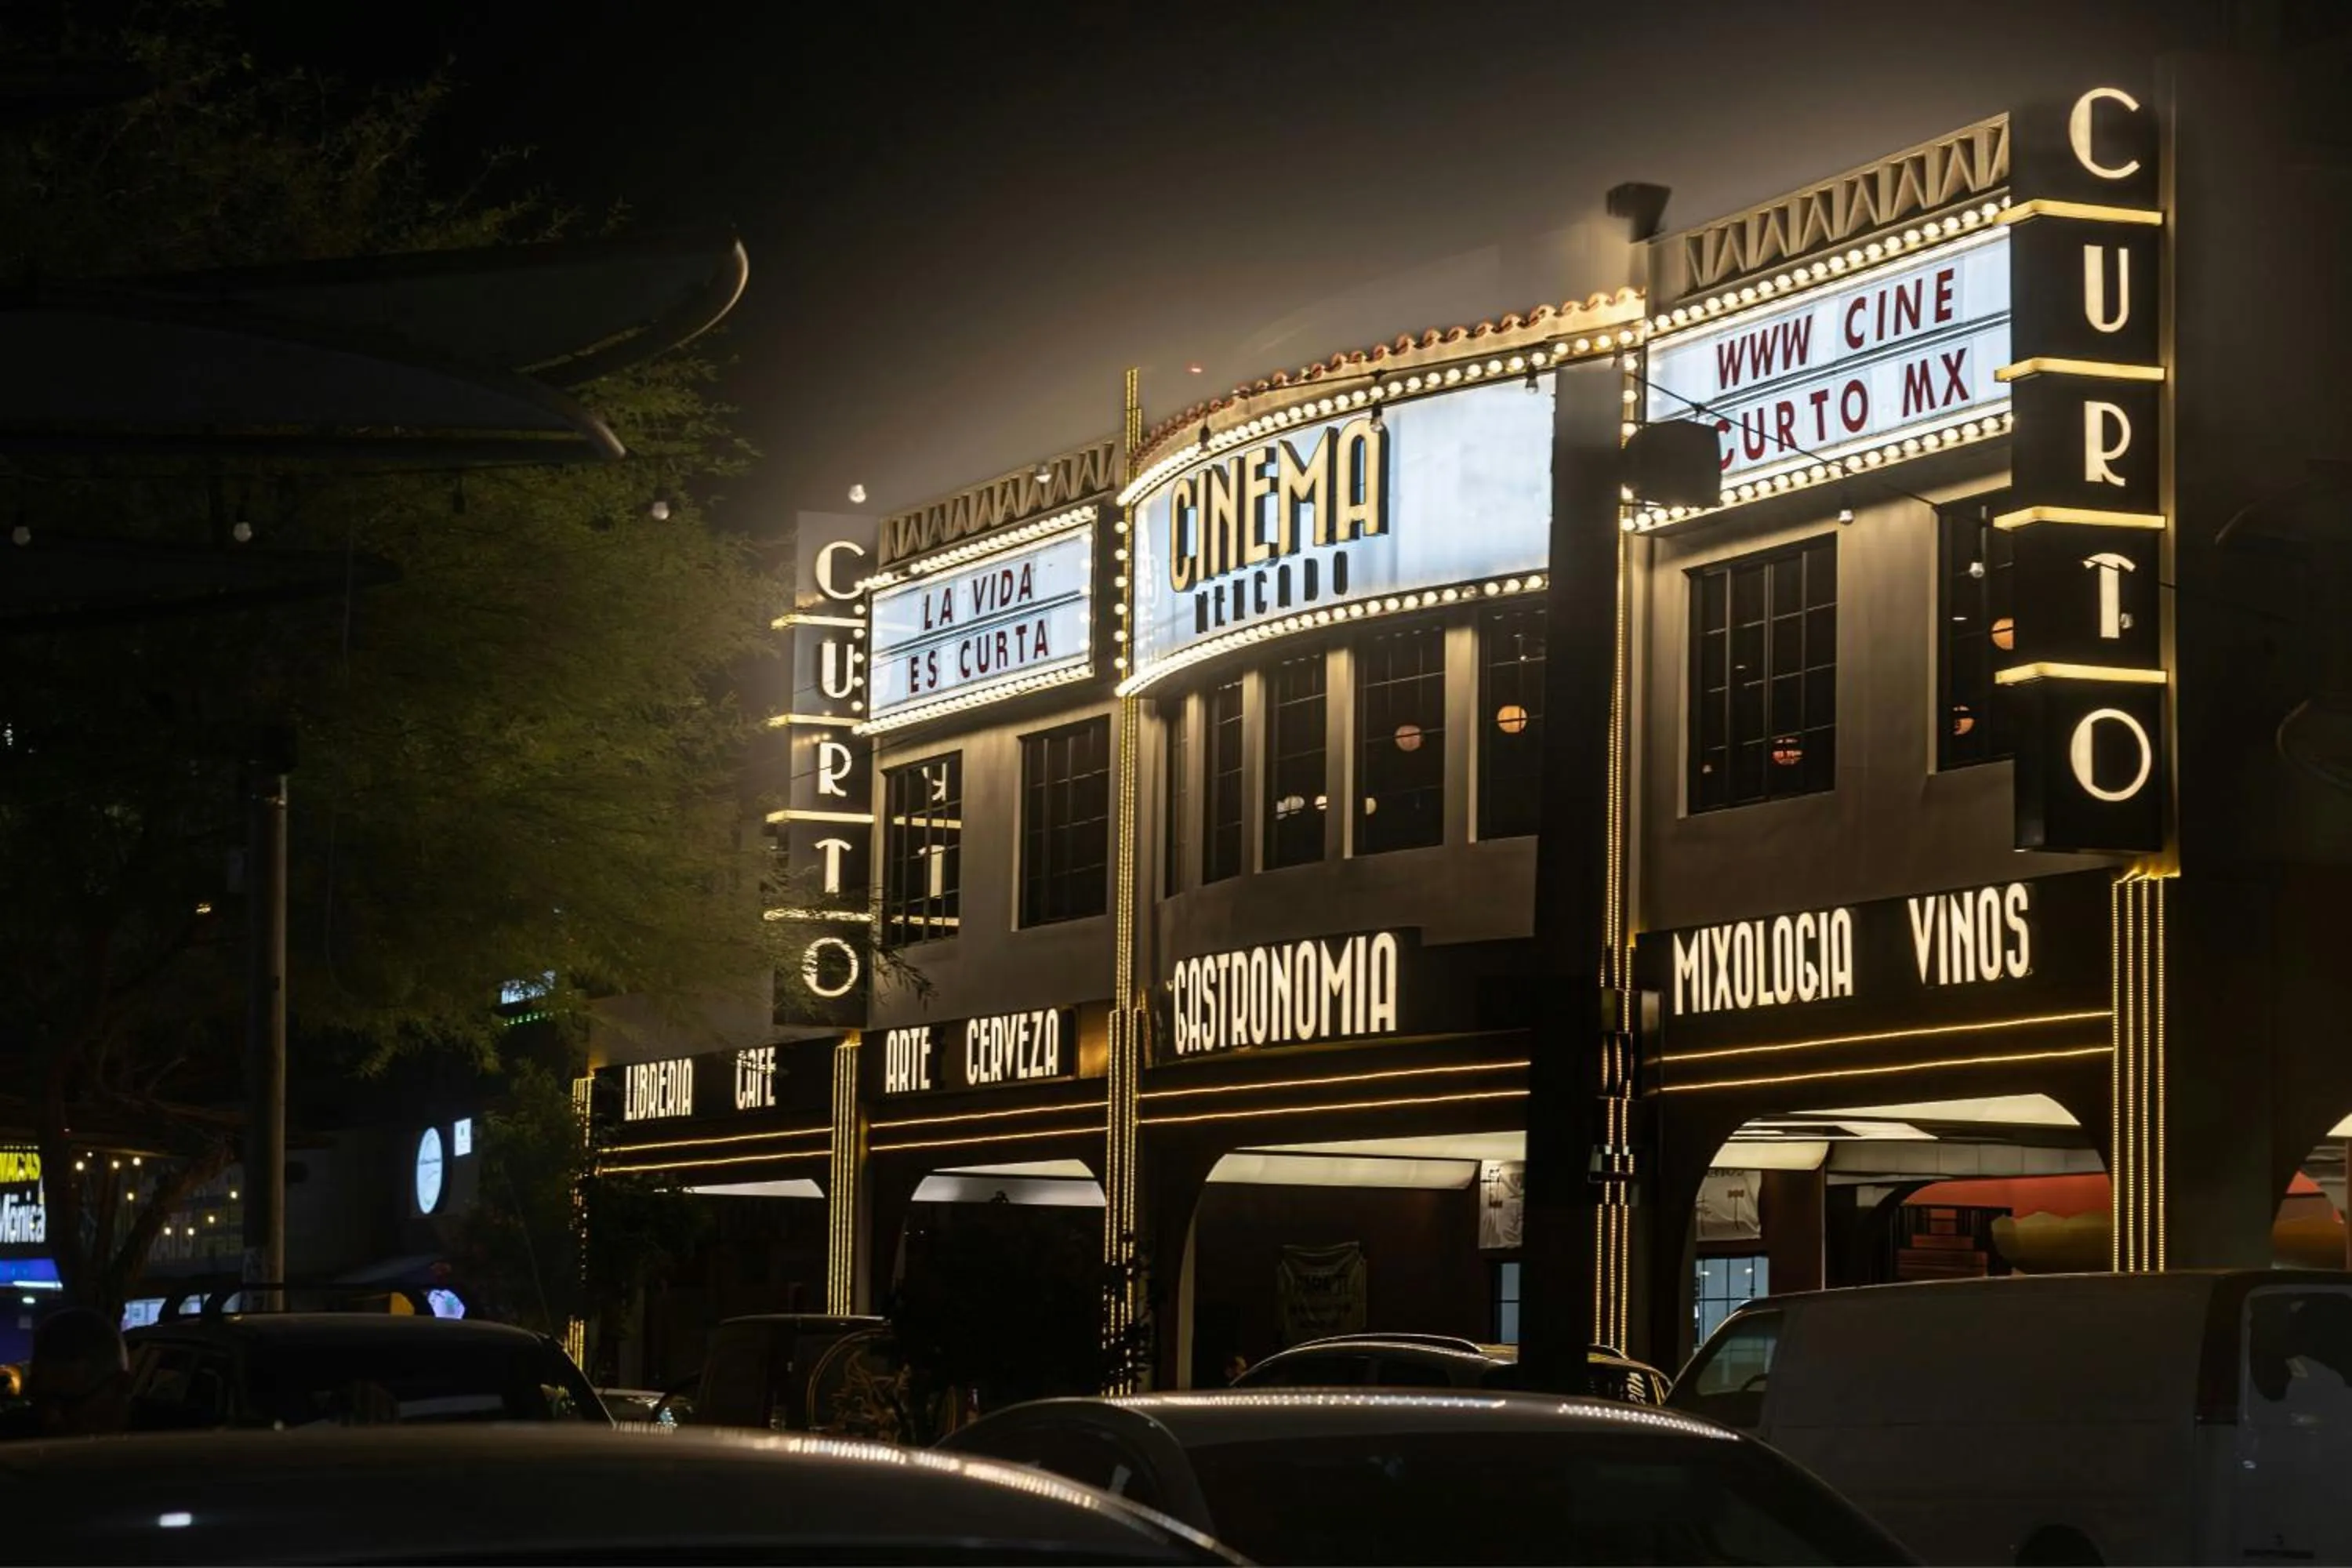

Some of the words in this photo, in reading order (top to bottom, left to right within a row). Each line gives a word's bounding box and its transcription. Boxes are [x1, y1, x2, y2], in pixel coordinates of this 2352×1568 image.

[1716, 314, 1813, 390] WWW
[1844, 268, 1955, 350] CINE
[1902, 348, 1969, 418] MX
[2069, 87, 2151, 802] CURTO
[1170, 417, 1389, 593] CINEMA
[924, 587, 953, 630] LA
[973, 563, 1033, 615] VIDA
[909, 651, 938, 694] ES
[959, 619, 1049, 678] CURTA
[803, 540, 865, 997] CURTO
[1673, 907, 1853, 1016] MIXOLOGIA
[1908, 882, 2029, 985] VINOS
[1174, 932, 1397, 1055] GASTRONOMIA
[624, 1058, 693, 1121] LIBRERIA
[735, 1046, 776, 1110] CAFE
[885, 1026, 931, 1093] ARTE
[966, 1008, 1058, 1085] CERVEZA
